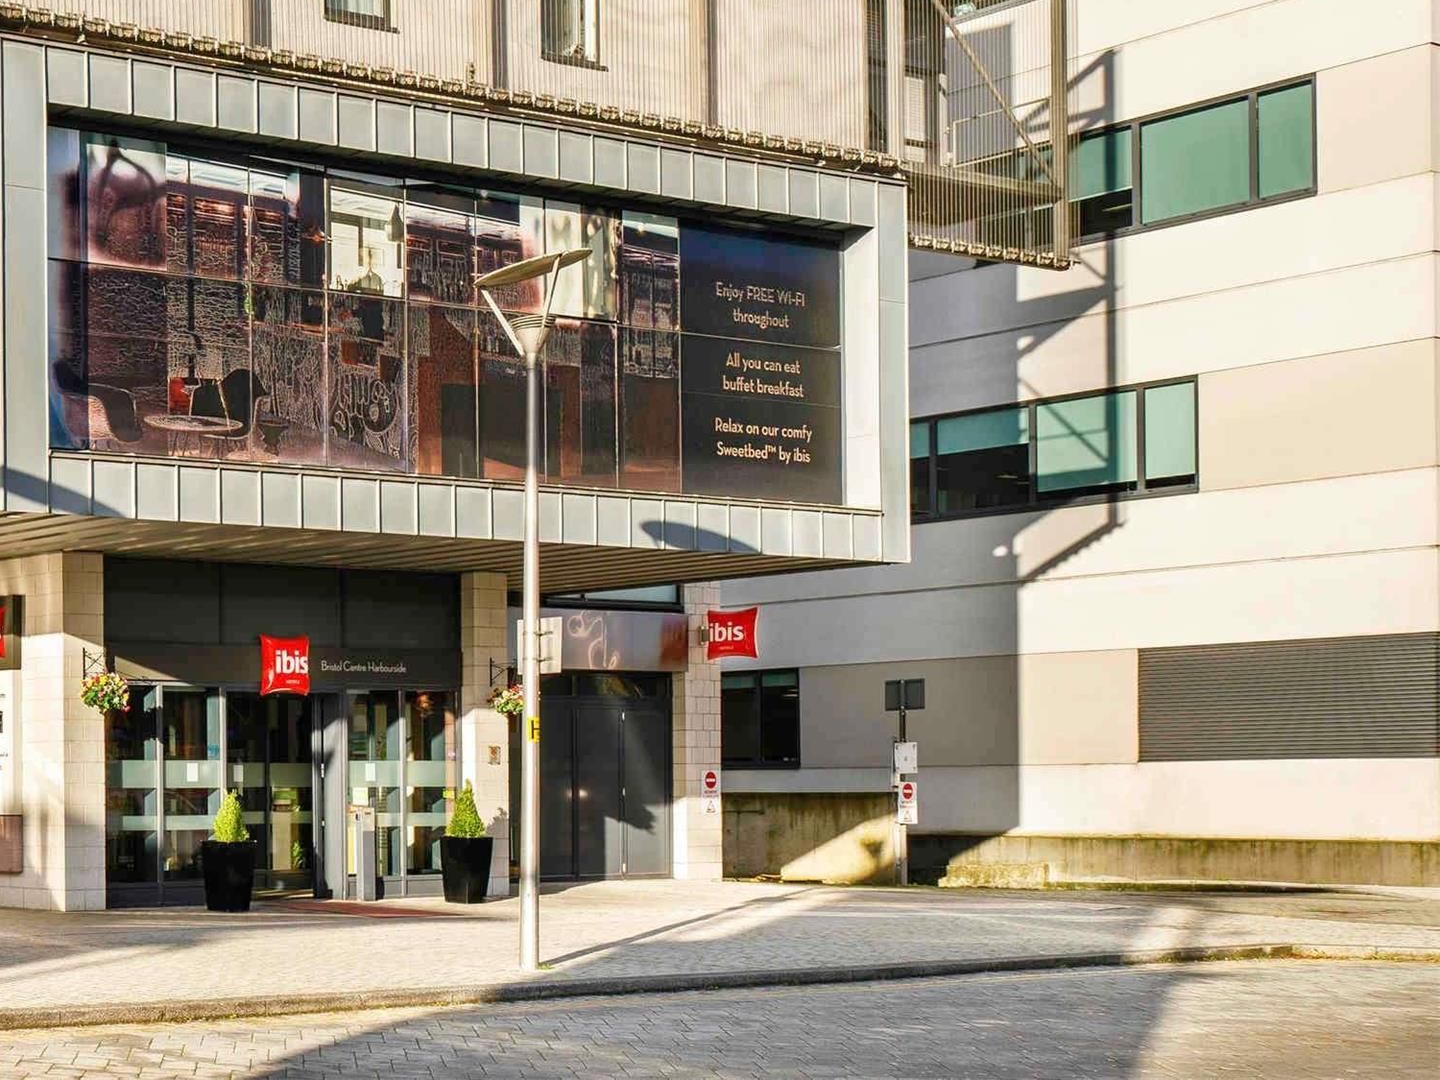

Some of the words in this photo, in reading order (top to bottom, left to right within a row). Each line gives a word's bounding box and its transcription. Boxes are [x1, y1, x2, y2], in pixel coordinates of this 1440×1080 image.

[715, 281, 744, 302] Enjoy
[746, 286, 775, 303] FREE
[733, 308, 790, 330] throughout
[726, 352, 741, 367] All
[742, 357, 762, 372] you
[763, 361, 782, 372] can
[784, 361, 801, 374] eat
[722, 375, 755, 393] buffet
[757, 377, 805, 398] breakfast
[714, 417, 744, 434] Relax
[746, 424, 760, 436] on
[761, 426, 779, 437] our
[781, 425, 813, 443] comfy
[778, 446, 791, 465] by
[793, 447, 811, 464] ibis
[709, 621, 744, 643] ibis
[275, 649, 309, 675] ibis
[321, 660, 343, 672] Bristol
[343, 661, 366, 672] Centre
[368, 661, 407, 674] Harbourside
